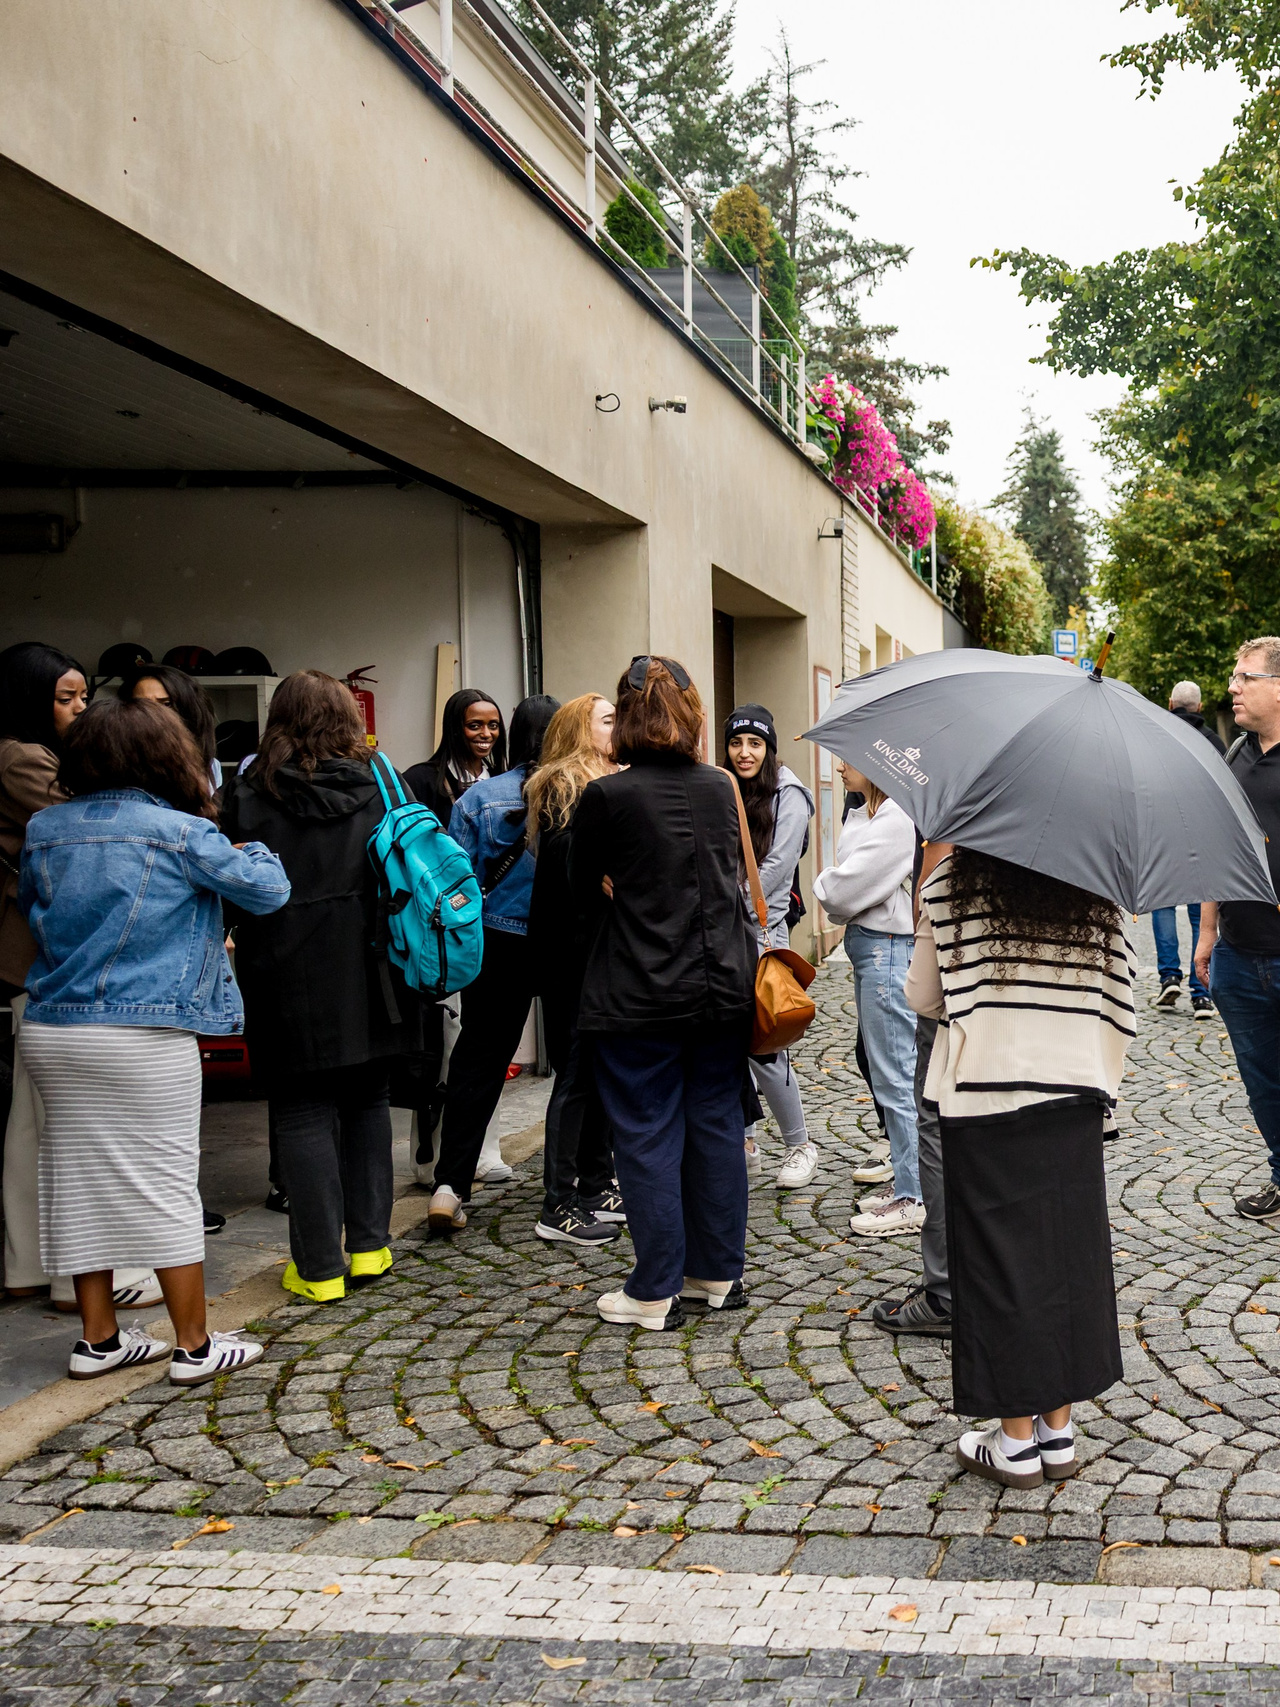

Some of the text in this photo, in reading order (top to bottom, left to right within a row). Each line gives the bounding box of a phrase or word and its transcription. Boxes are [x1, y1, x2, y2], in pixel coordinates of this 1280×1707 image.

[872, 739, 930, 786] KING DAVID
[558, 1218, 580, 1233] N
